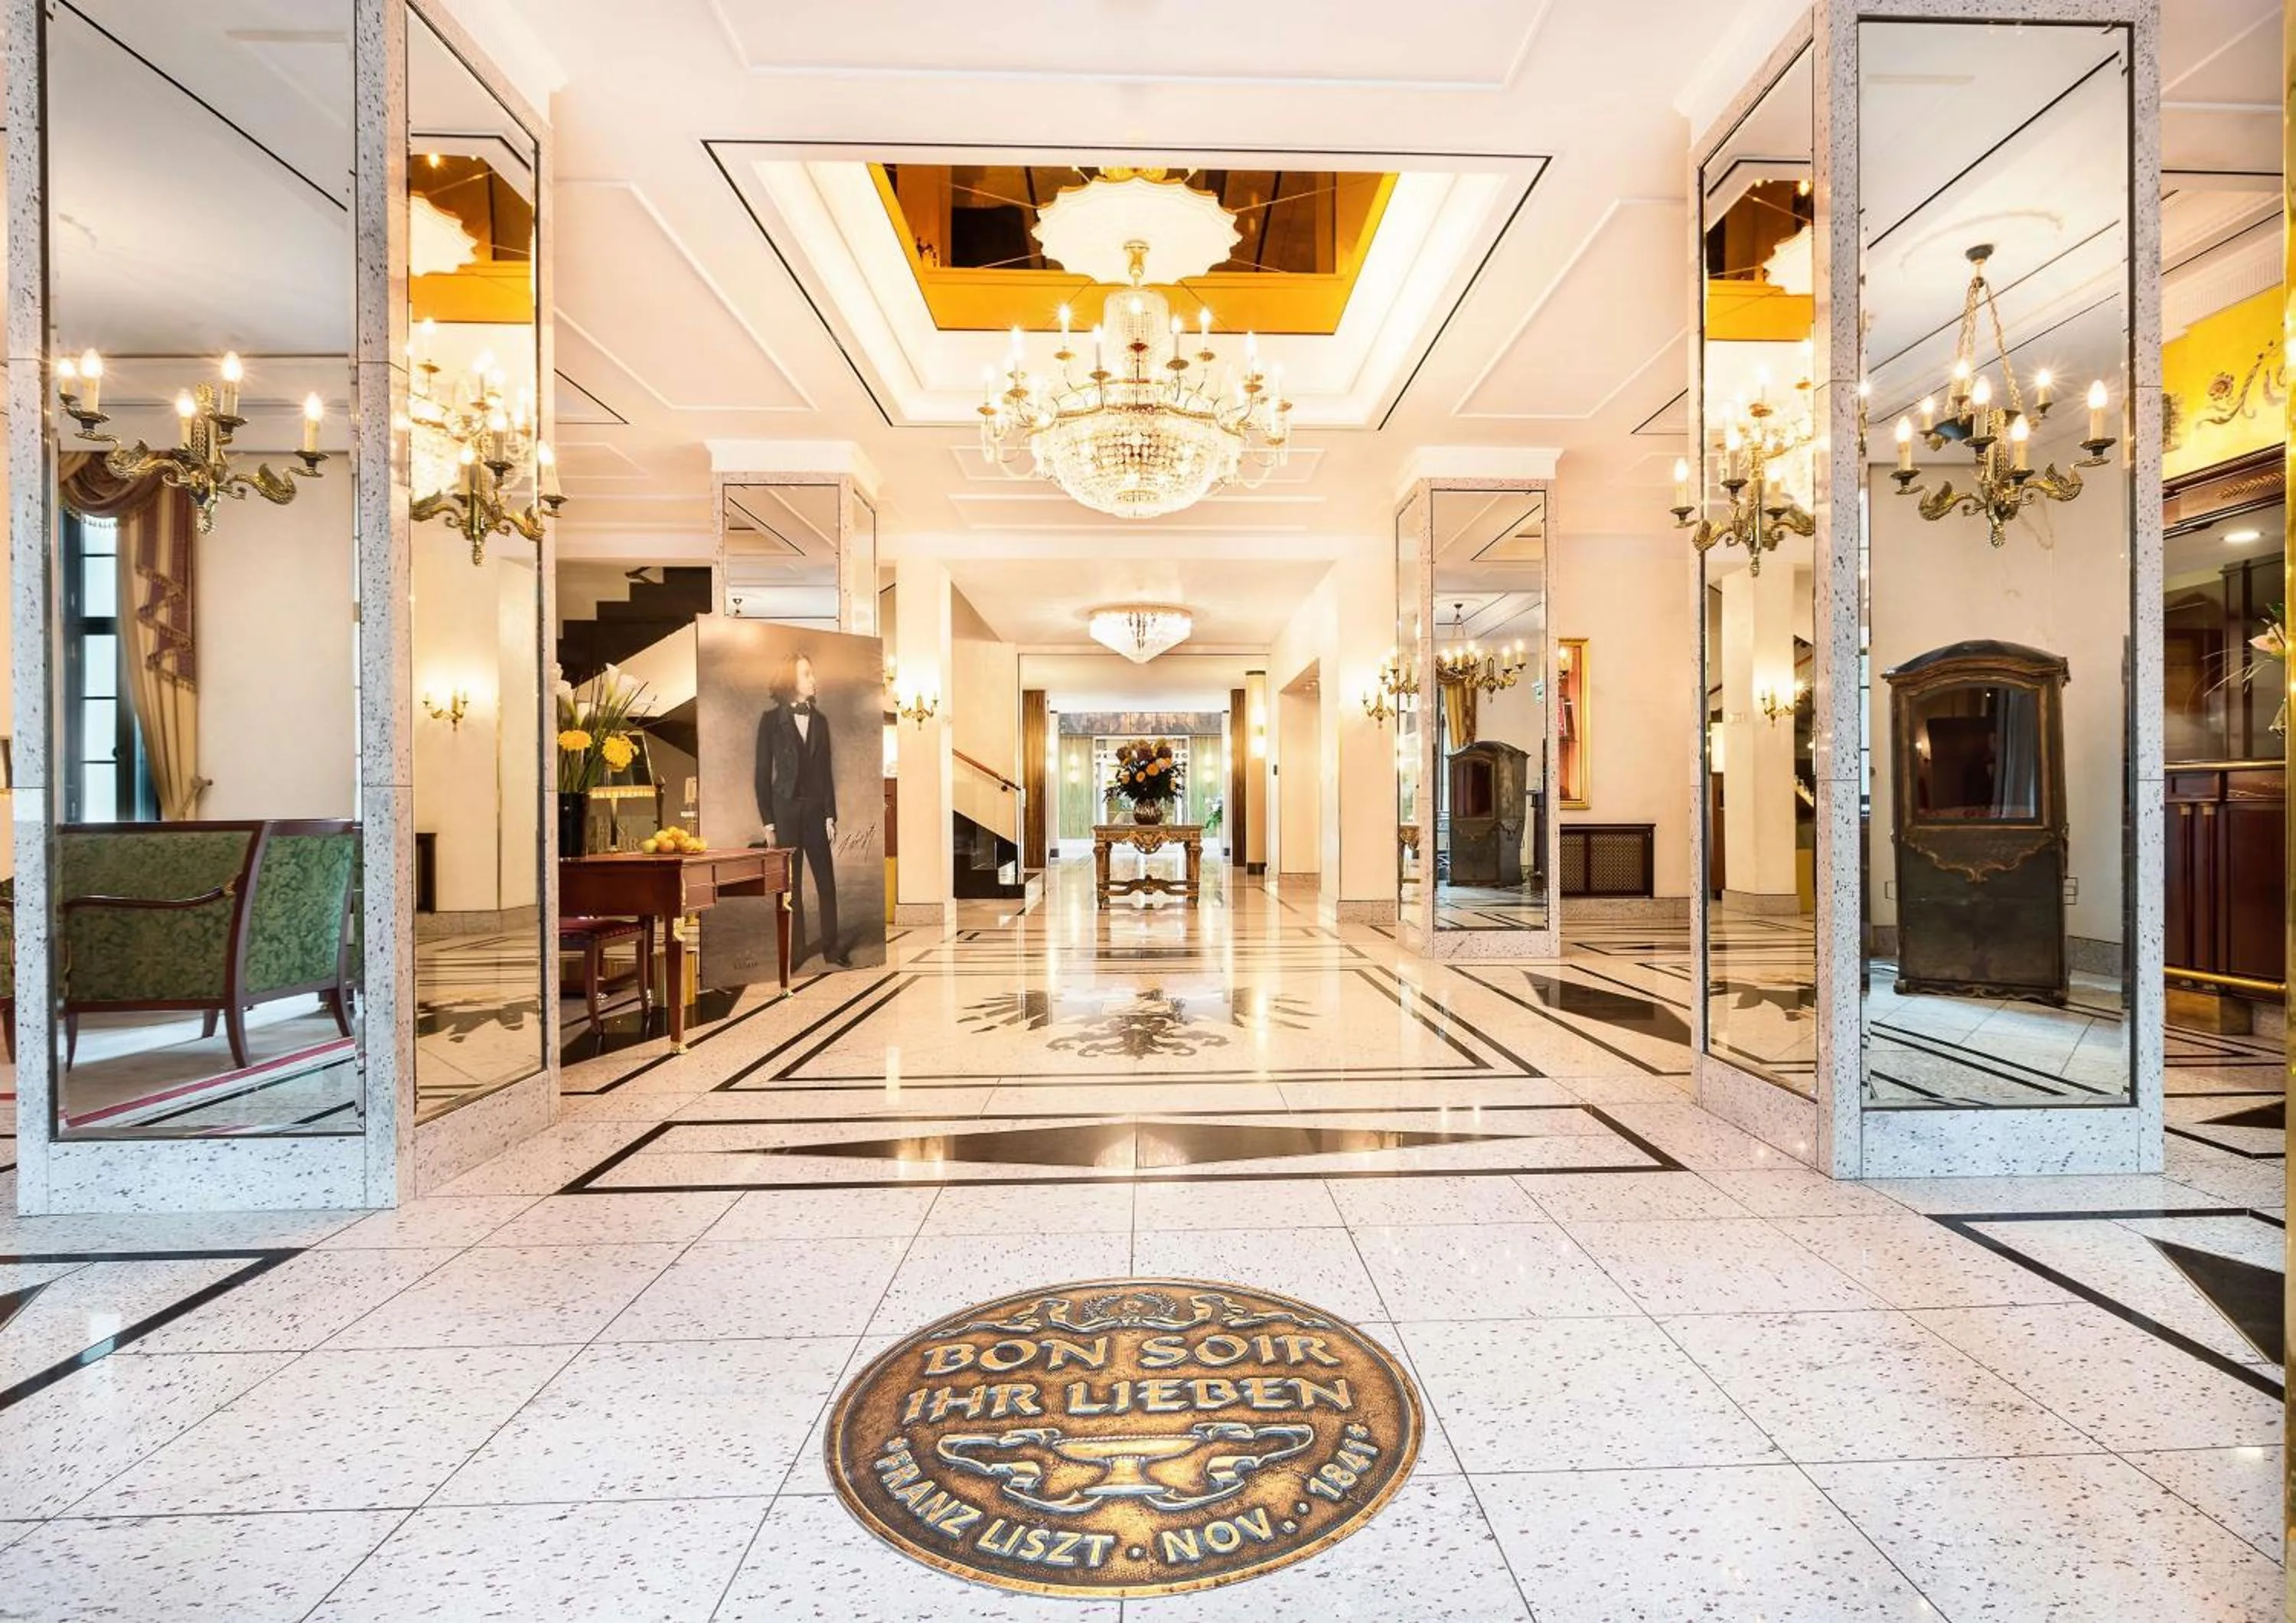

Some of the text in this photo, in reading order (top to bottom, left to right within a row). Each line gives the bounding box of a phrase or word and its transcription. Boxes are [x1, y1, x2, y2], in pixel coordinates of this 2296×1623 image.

[924, 1334, 1341, 1376] BON SOIR
[905, 1377, 1353, 1424] IHR LIEBEN
[873, 1449, 983, 1540] FRANZ
[976, 1518, 1115, 1569] LISZT
[1308, 1438, 1379, 1501] 1841
